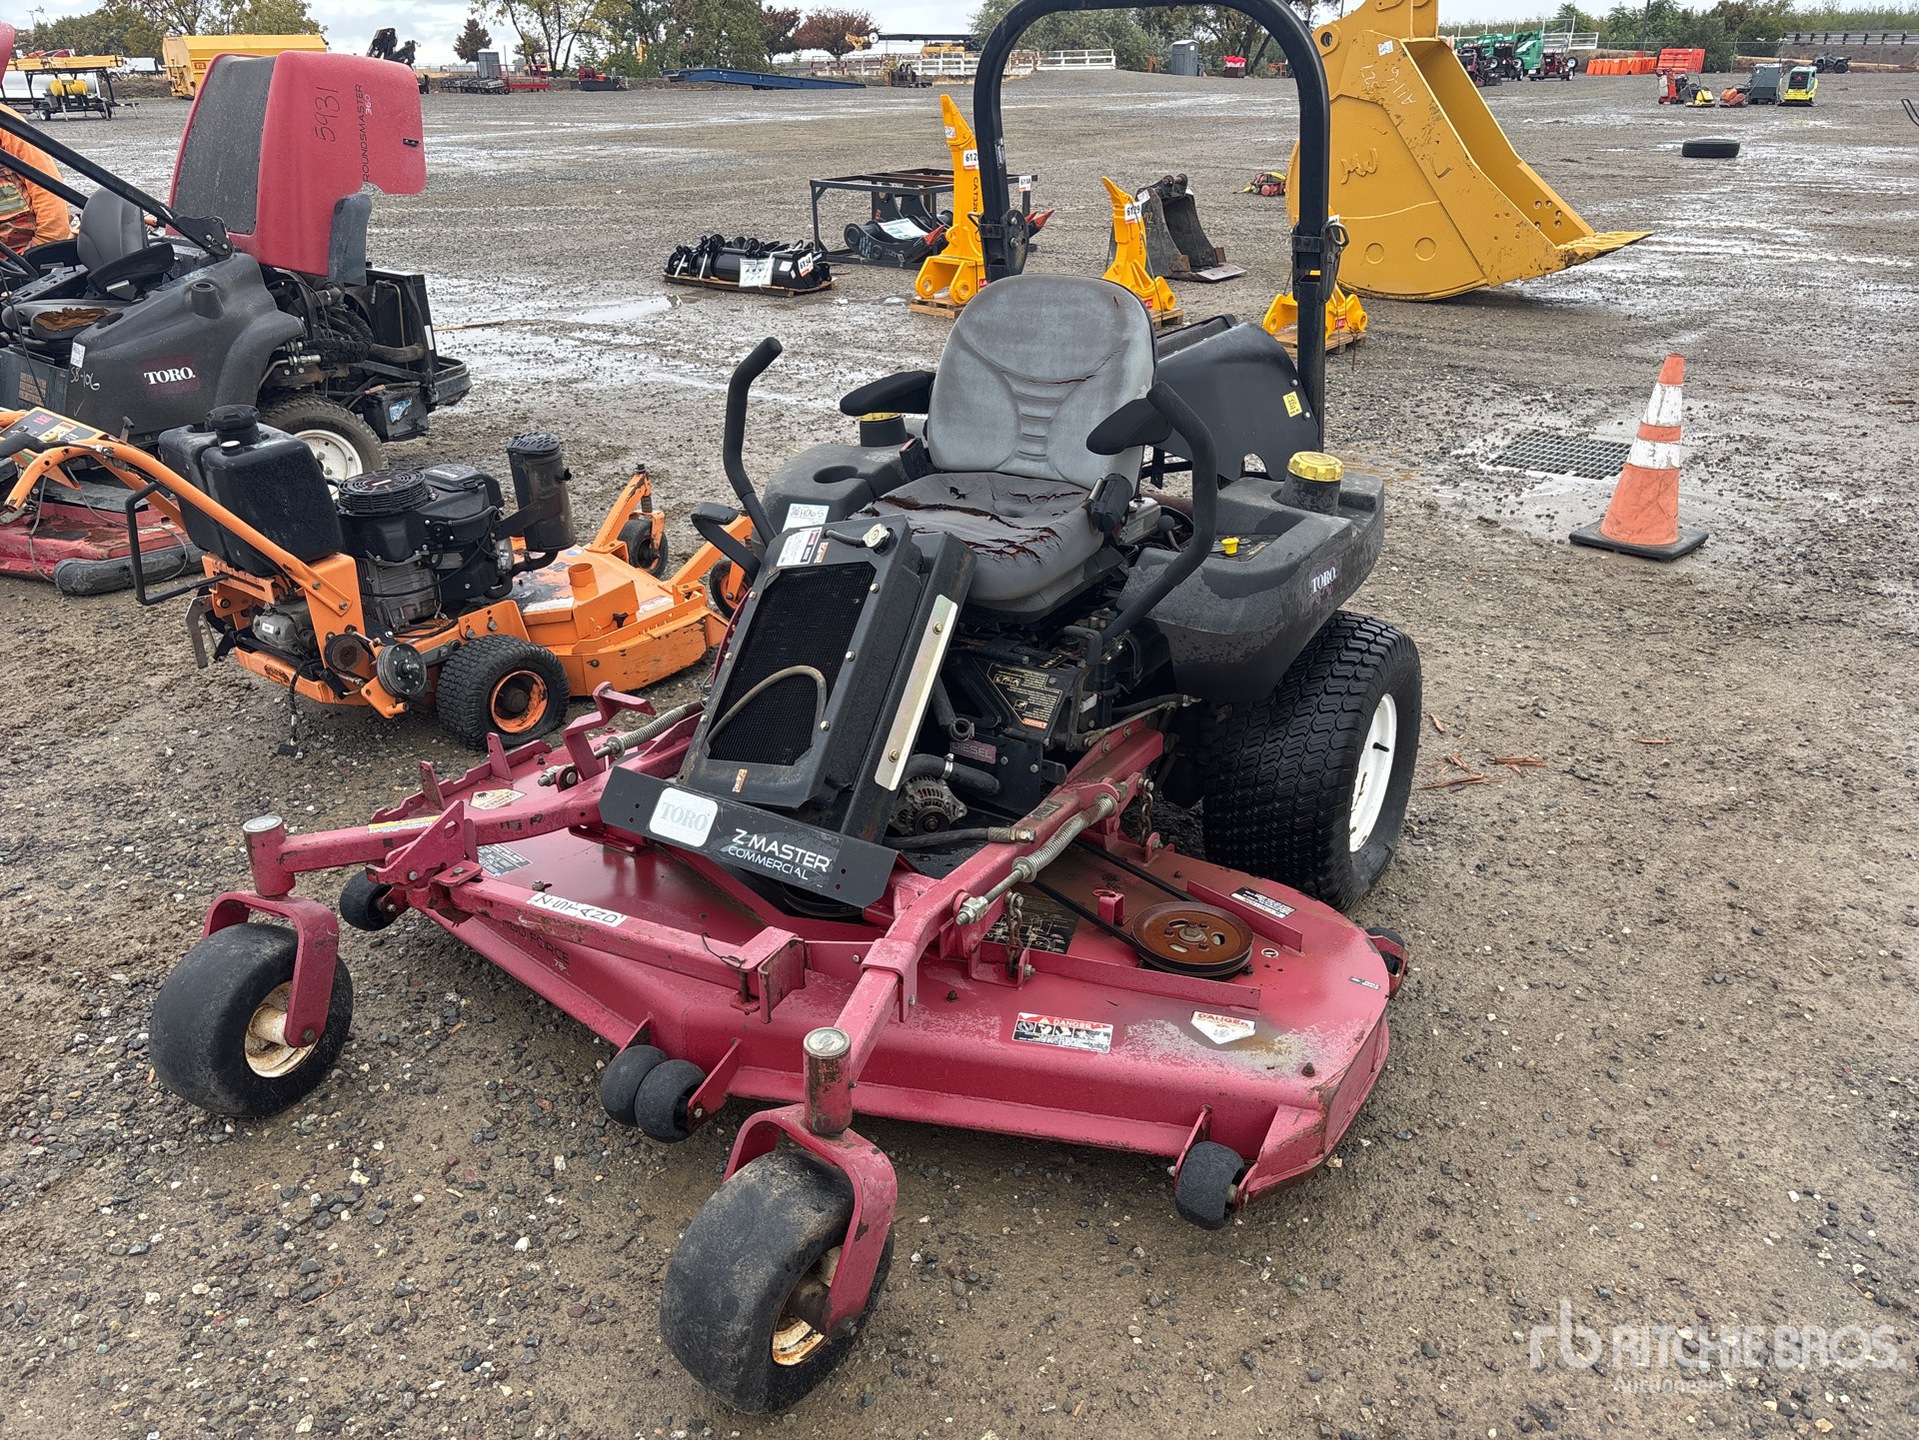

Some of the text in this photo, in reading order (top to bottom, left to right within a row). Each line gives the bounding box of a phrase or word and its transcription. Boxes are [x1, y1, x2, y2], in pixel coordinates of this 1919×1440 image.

[315, 86, 340, 142] 5931
[364, 94, 373, 115] 360
[355, 84, 370, 182] ROUNDSMASTER
[965, 152, 978, 163] 612
[952, 741, 993, 760] DIESEL
[661, 801, 711, 832] TORO
[727, 845, 809, 881] COMMERCIAL
[731, 828, 832, 873] Z MASTER
[529, 930, 570, 965] FORCE
[1053, 1019, 1091, 1029] DANGER
